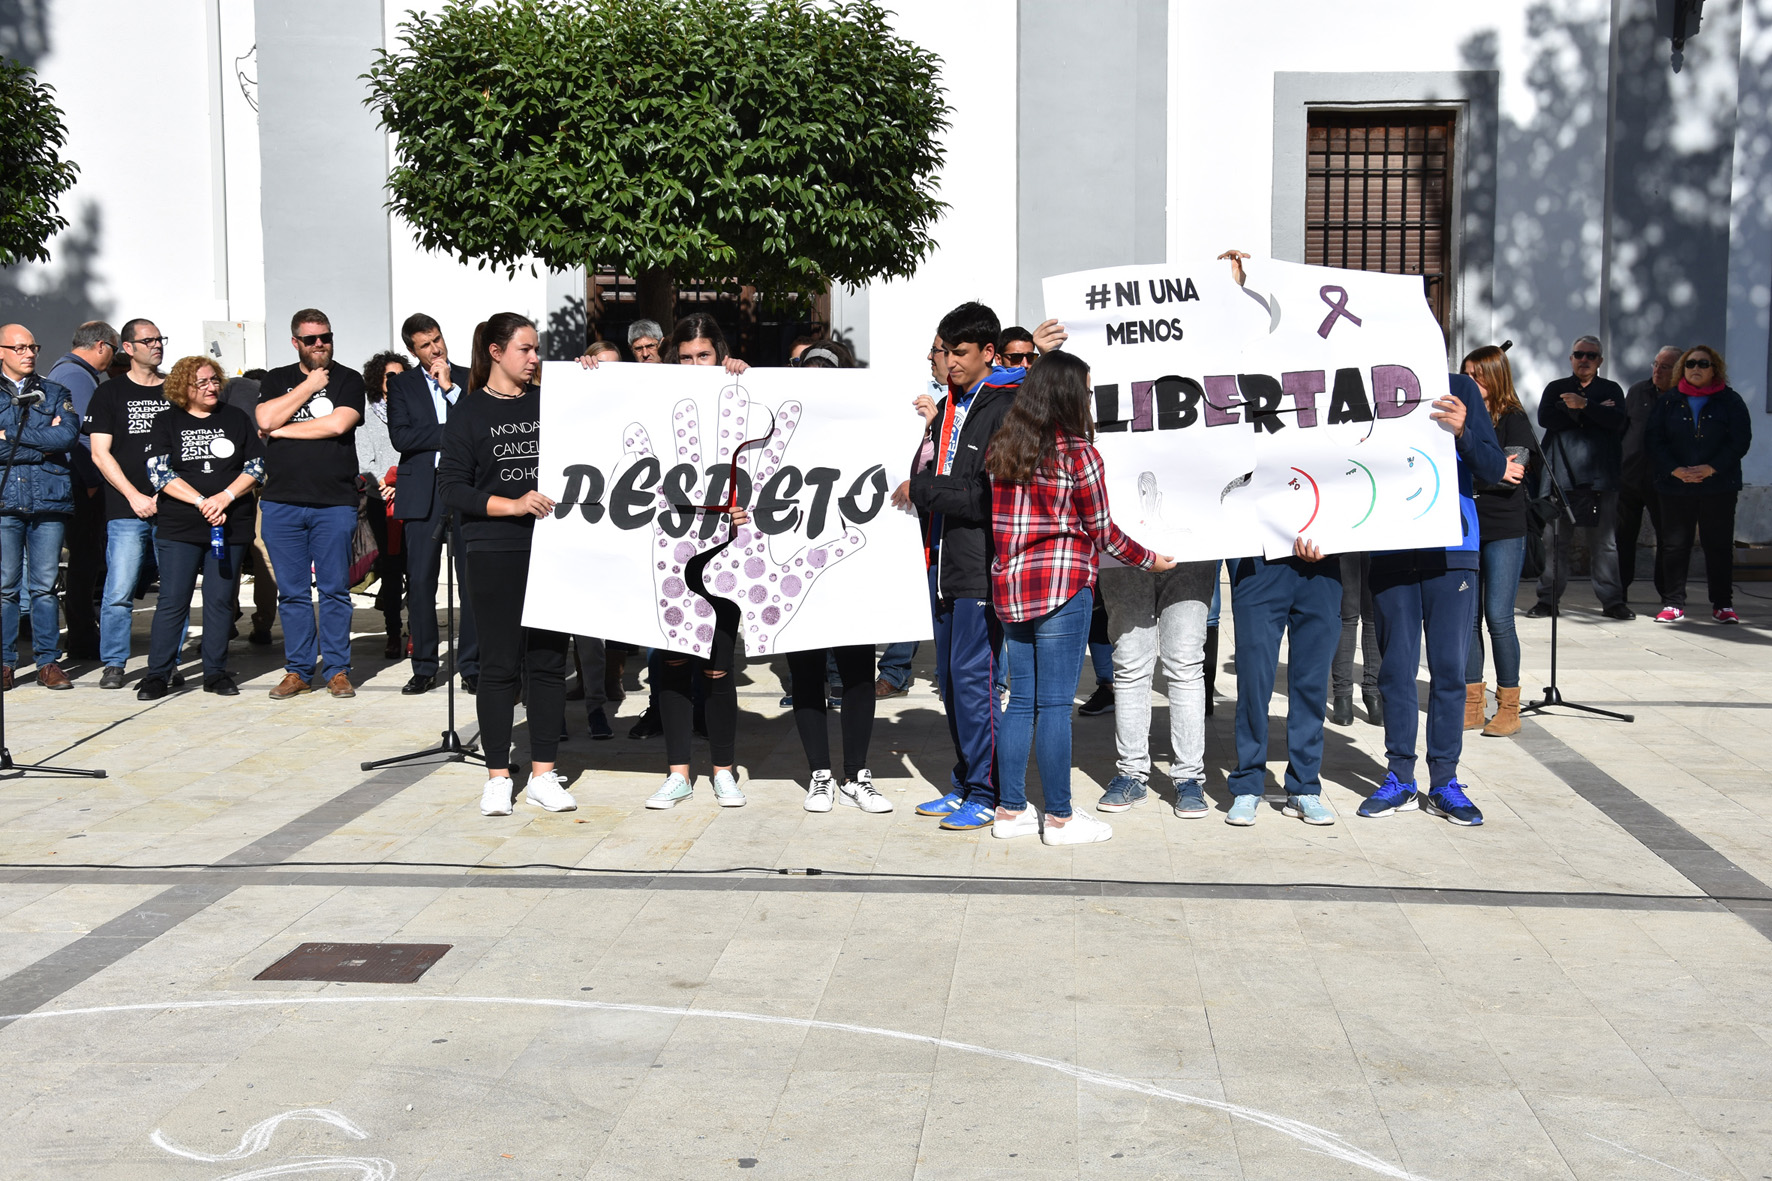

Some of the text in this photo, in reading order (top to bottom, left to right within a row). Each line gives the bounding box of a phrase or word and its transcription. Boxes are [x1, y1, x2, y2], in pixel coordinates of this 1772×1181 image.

[1148, 277, 1200, 304] UNA
[1106, 318, 1183, 346] MENOS
[1093, 364, 1421, 434] LIBERTAD
[128, 419, 153, 430] 25N
[490, 420, 540, 438] MONDA
[181, 445, 209, 458] 25N
[500, 467, 524, 482] GO
[554, 457, 889, 541] RESPETO
